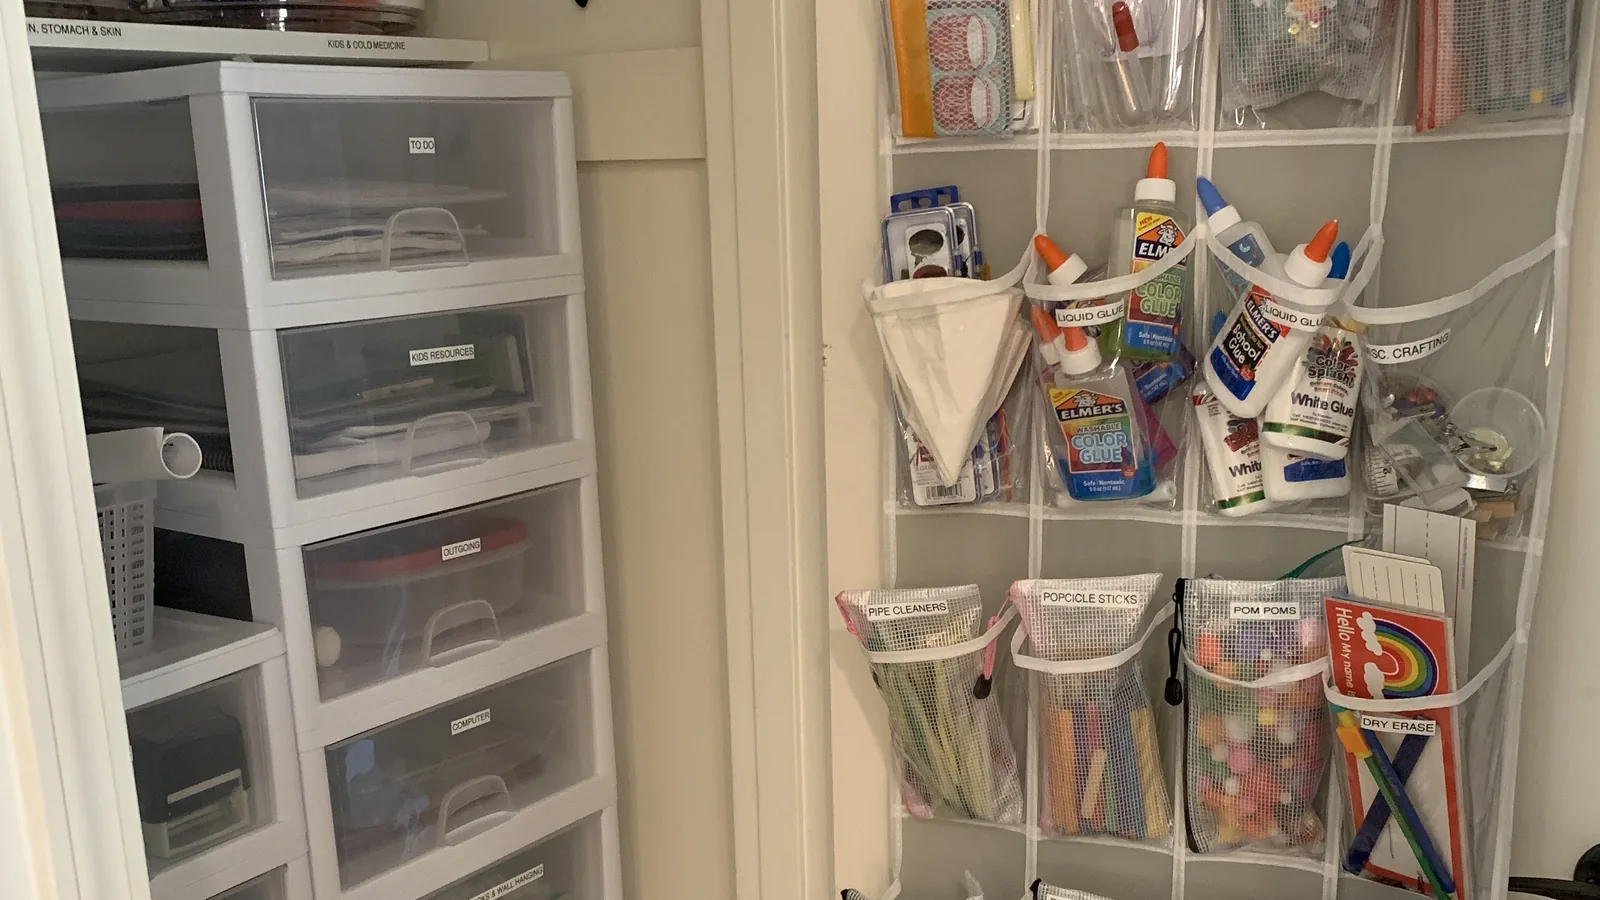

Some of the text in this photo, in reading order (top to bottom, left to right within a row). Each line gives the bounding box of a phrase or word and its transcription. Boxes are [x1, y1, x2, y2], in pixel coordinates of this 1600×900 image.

[41, 24, 89, 35] STOMACH
[91, 26, 98, 36] &
[100, 26, 122, 37] SKIN
[327, 40, 406, 50] KIDS & COLD MEDICINE
[410, 140, 435, 150] TO DO
[1135, 281, 1182, 303] COLOR
[1057, 304, 1124, 322] LIQUID GLUE
[1140, 297, 1177, 318] GLUE
[1265, 304, 1323, 327] LIQUID GLU
[1246, 300, 1278, 340] ELMER'S
[1228, 337, 1246, 364] Glue
[1232, 323, 1261, 361] School
[1367, 332, 1449, 360] SC. CRAFTING
[411, 347, 475, 362] KIDS RESOURCES
[1315, 355, 1349, 372] Color
[1307, 365, 1355, 389] Splash!
[1061, 403, 1123, 419] ELMER'S
[1291, 391, 1354, 418] White Glue
[1076, 422, 1122, 434] WASHABLE
[1071, 431, 1127, 450] COLOR
[1080, 446, 1123, 464] GLUE
[1229, 461, 1262, 477] Whit
[443, 540, 480, 557] OUTGOING
[1043, 592, 1138, 604] POPCICLE STICKS
[868, 602, 947, 617] PIPE CLEANERS
[1233, 606, 1297, 615] POM POMS
[1335, 606, 1355, 640] Hello
[1340, 642, 1352, 659] My
[1343, 660, 1354, 689] name
[452, 711, 490, 731] COMPUTER
[1362, 717, 1434, 733] DRY ERASE
[496, 883, 514, 895] WALL
[514, 867, 543, 886] HANGING
